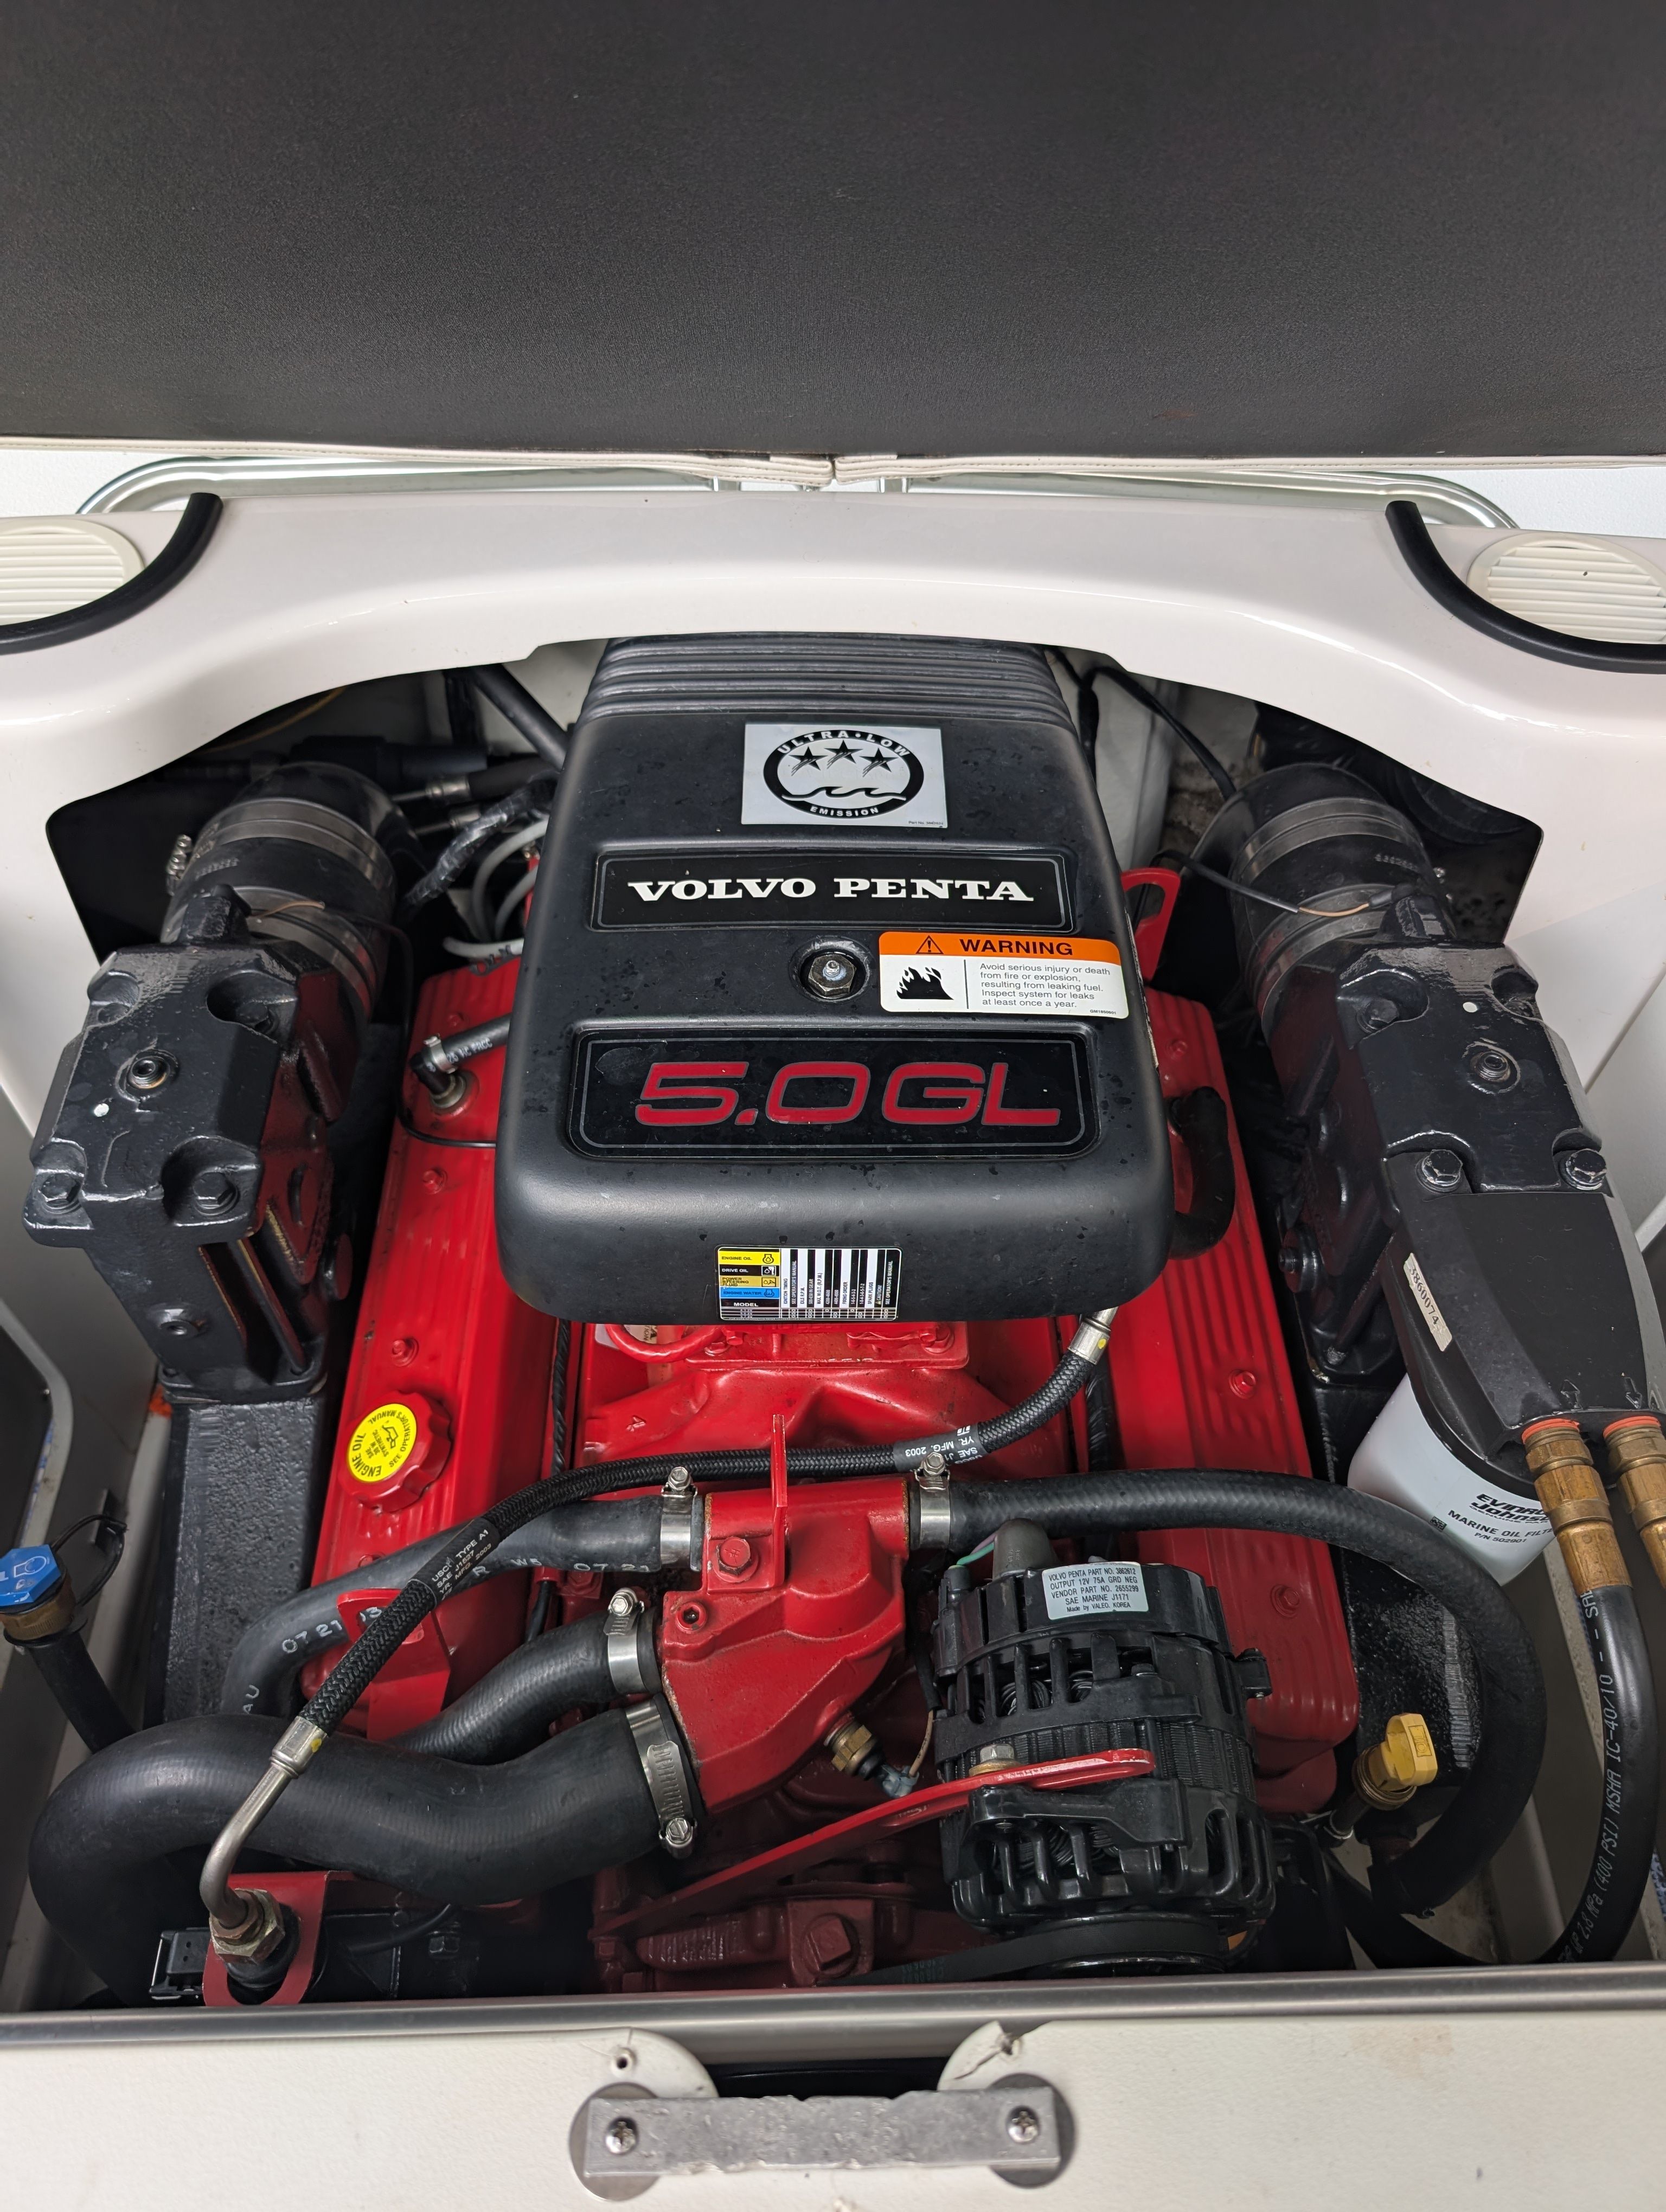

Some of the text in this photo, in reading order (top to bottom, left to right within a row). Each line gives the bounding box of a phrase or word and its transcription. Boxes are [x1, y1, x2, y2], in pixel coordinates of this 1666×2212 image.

[777, 730, 912, 756] ULTRA LOW
[810, 806, 879, 817] EMISSION
[627, 877, 1034, 902] VOLVO PENTA
[959, 938, 1073, 956] WARNING
[980, 963, 1005, 972] Avoid
[1008, 964, 1042, 972] serious
[1045, 965, 1069, 975] injury
[1085, 967, 1110, 975] death
[981, 972, 1002, 980] from
[1004, 972, 1019, 980] fire
[1034, 973, 1080, 983] explosion,
[981, 980, 1104, 992] resulting from leaking fuel.
[982, 989, 1016, 999] Inspect
[1018, 992, 1053, 1001] system
[1069, 992, 1094, 1000] leaks
[994, 999, 1017, 1007] least
[1053, 1001, 1077, 1009] year.
[1409, 1267, 1439, 1324] 3860074
[368, 1410, 411, 1468] SEE OPERATOR'S MANUAL
[905, 1436, 975, 1457] YR. MFG. 2003
[353, 1433, 382, 1477] ENGINE OIL
[958, 1446, 978, 1458] SAE
[1447, 1509, 1498, 1535] MARINE
[456, 1539, 478, 1558] TYPE
[479, 1529, 489, 1541] A1
[1474, 1532, 1491, 1540] P/N
[439, 1582, 452, 1594] YR.
[476, 1543, 491, 1560] 2003
[1048, 1572, 1067, 1582] VOLVO
[1068, 1570, 1087, 1578] PENTA
[1088, 1568, 1102, 1576] PART
[437, 1571, 453, 1588] SAE
[1050, 1579, 1075, 1590] OUTPUT
[1051, 1589, 1078, 1599] VENDOR
[1080, 1586, 1097, 1594] PART
[1065, 1597, 1079, 1606] SAE
[1082, 1593, 1108, 1603] MARINE
[1598, 1674, 1622, 1764] IC-40/10
[1605, 1769, 1623, 1814] MSHA
[1605, 1817, 1620, 1858] PSI)
[1593, 1858, 1613, 1892] (400
[1585, 1893, 1604, 1918] MPa
